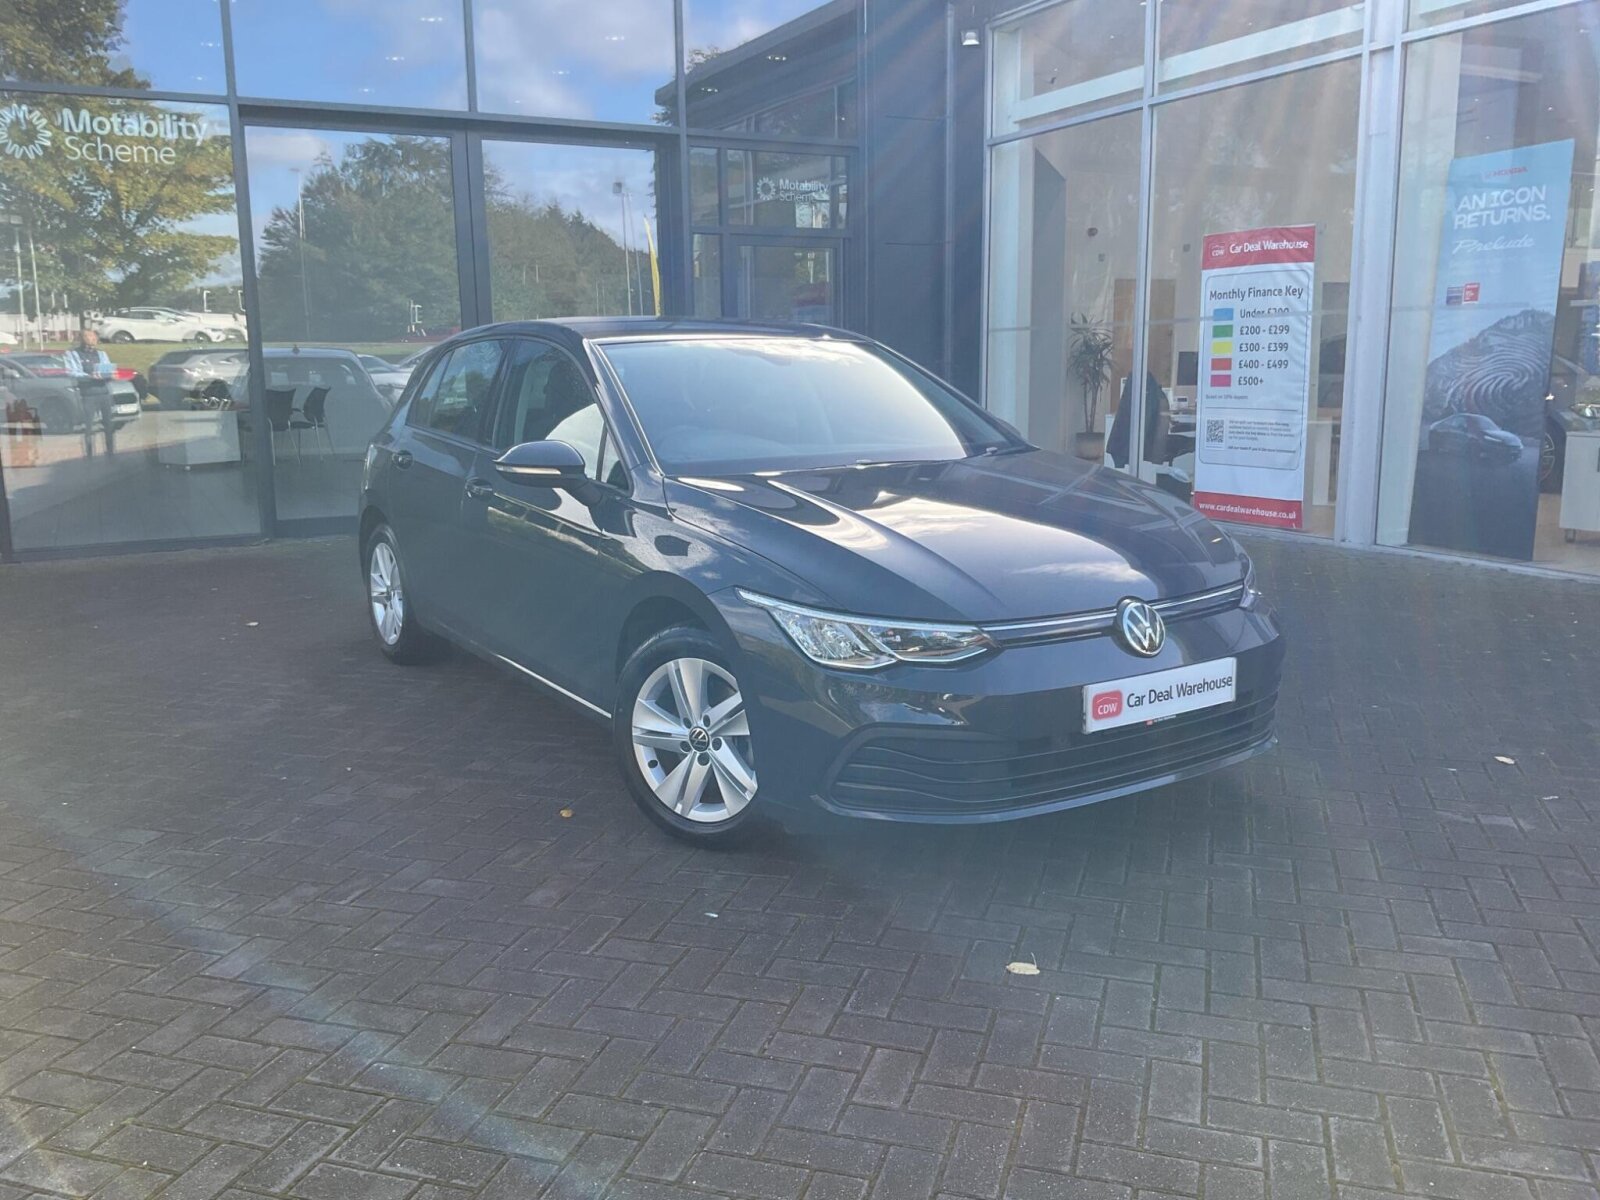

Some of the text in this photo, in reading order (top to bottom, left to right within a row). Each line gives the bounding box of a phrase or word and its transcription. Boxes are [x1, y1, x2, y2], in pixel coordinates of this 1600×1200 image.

[62, 107, 208, 146] Motability
[64, 135, 176, 165] Scheme
[779, 178, 829, 194] Motability
[1457, 184, 1547, 212] AN ICON
[1454, 204, 1551, 230] RETURNS.
[1229, 239, 1309, 254] Car Deal Warehouse
[1452, 234, 1535, 255] Prelude
[1209, 285, 1304, 301] Monthly Finance Key
[1240, 325, 1260, 335] £200
[1268, 324, 1290, 335] £299
[1239, 342, 1260, 352] £300
[1267, 342, 1289, 352] £399
[1238, 359, 1260, 369] £400
[1267, 359, 1289, 369] £499
[1238, 376, 1264, 386] £500+
[1097, 675, 1233, 716] CDW Car Deal Warehouse
